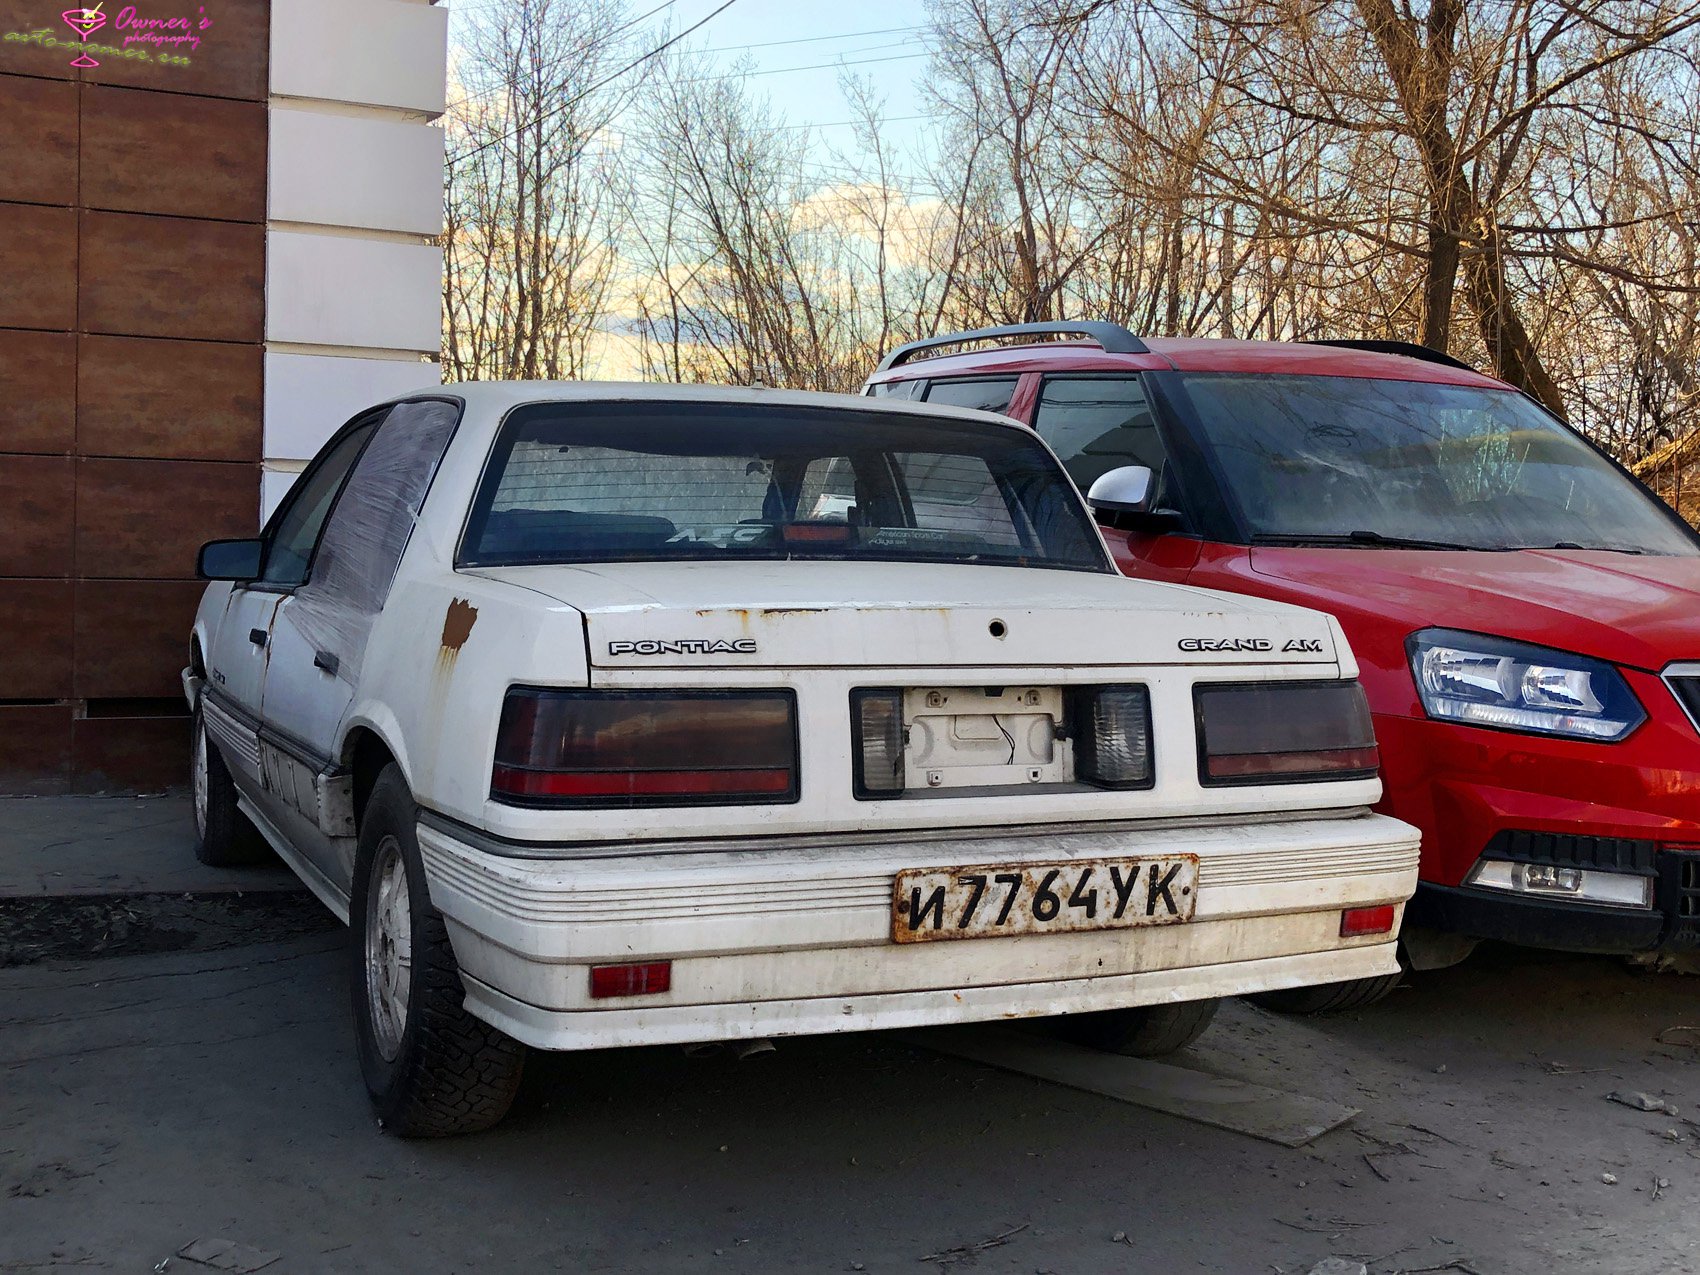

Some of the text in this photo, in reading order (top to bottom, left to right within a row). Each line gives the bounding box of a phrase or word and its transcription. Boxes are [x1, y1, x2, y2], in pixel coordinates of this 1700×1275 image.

[609, 639, 757, 656] PONTIAC
[1178, 638, 1323, 652] GRAND AM
